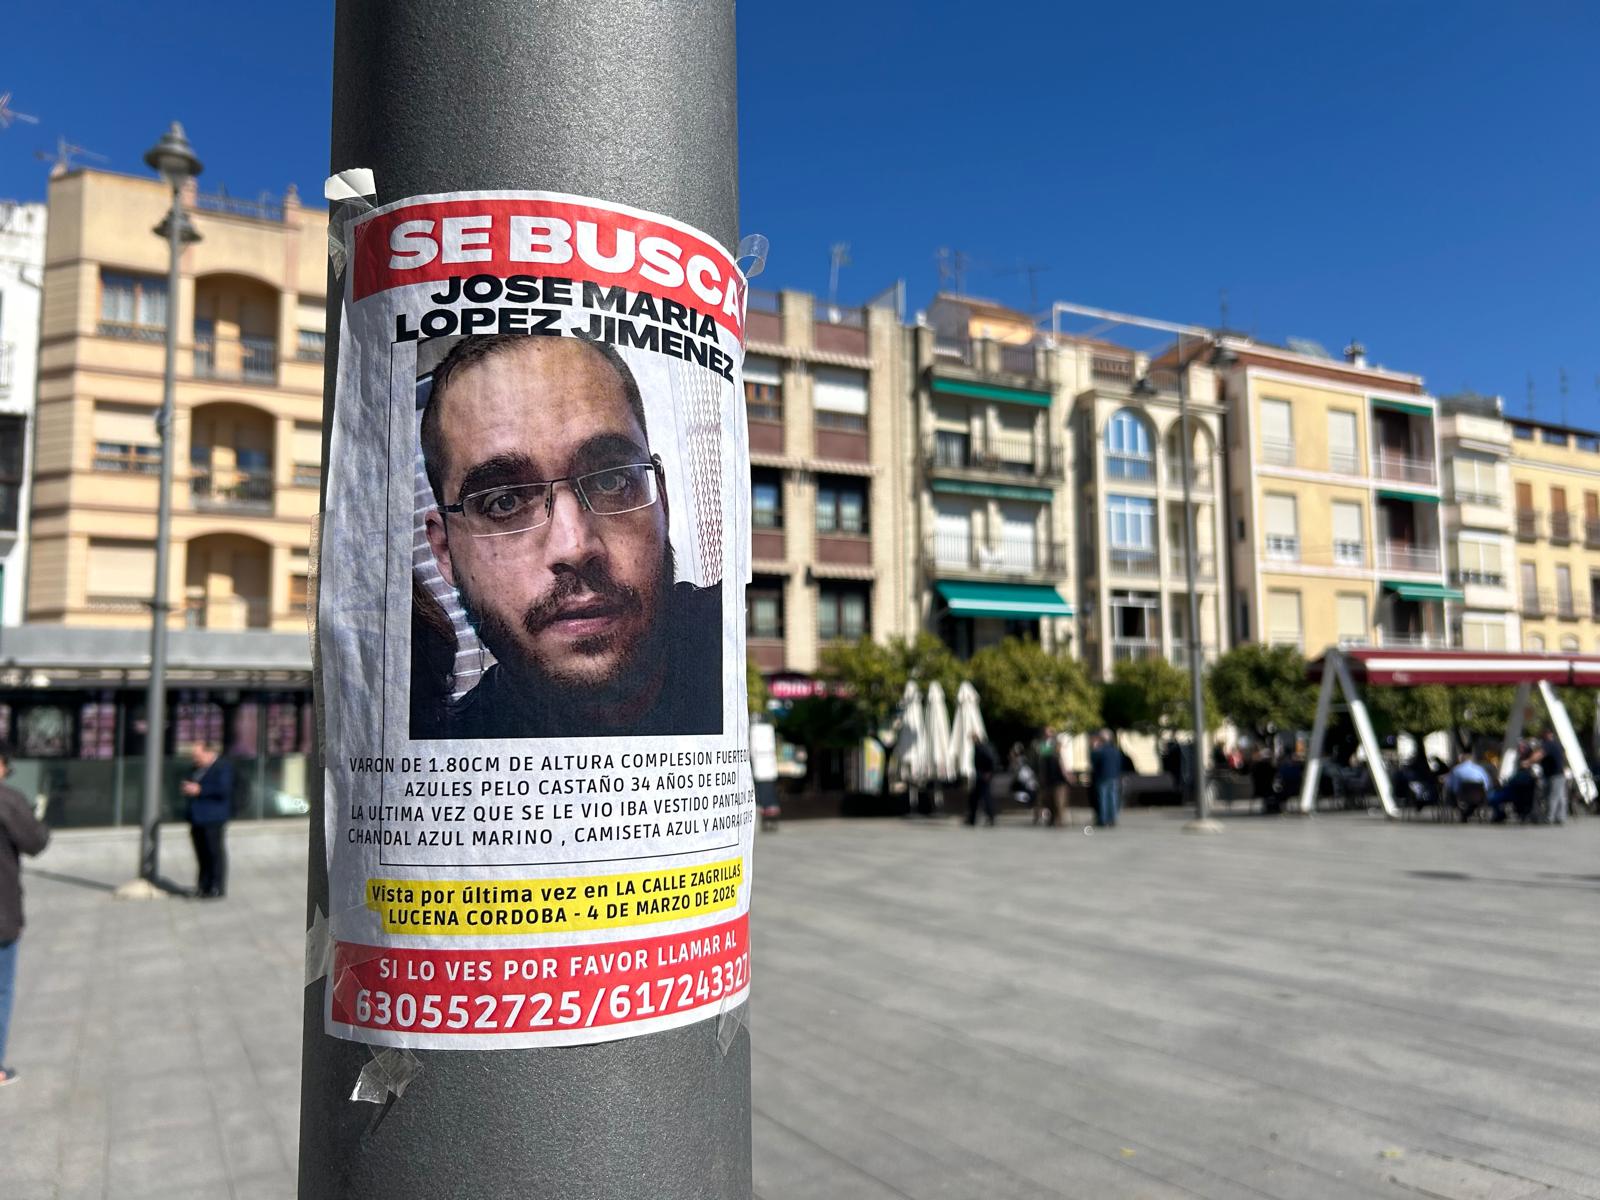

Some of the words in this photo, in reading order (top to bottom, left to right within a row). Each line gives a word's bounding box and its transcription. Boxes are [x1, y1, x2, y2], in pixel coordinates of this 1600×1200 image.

[388, 215, 493, 270] SE
[509, 215, 743, 329] BUSCA
[430, 273, 573, 306] JOSE
[582, 280, 720, 345] MARIA
[396, 307, 562, 342] LOPEZ
[570, 313, 734, 384] JIMENEZ
[349, 757, 394, 773] VARON
[401, 757, 422, 773] DE
[429, 756, 500, 773] 1.80CM
[509, 756, 533, 772] DE
[541, 754, 614, 771] ALTURA
[621, 751, 712, 769] COMPLESION
[405, 781, 472, 797] AZULES
[481, 780, 530, 797] PELO
[539, 775, 624, 795] CASTAÑO
[631, 777, 650, 792] 34
[656, 772, 694, 790] AÑOS
[698, 773, 712, 788] DE
[715, 771, 736, 786] EDAD
[351, 805, 363, 820] LA
[369, 805, 424, 822] ULTIMA
[431, 806, 465, 822] VEZ
[473, 805, 513, 822] QUE
[522, 804, 544, 820] SE
[553, 804, 573, 819] LE
[581, 802, 613, 818] VIO
[621, 800, 648, 816] IBA
[654, 796, 709, 814] VESTIDO
[348, 828, 411, 846] CHANDAL
[418, 831, 464, 846] AZUL
[472, 829, 553, 846] MARINO
[575, 823, 660, 843] CAMISETA
[666, 819, 699, 837] AZUL
[703, 818, 709, 832] Y
[372, 885, 414, 903] Vista
[421, 889, 455, 907] por
[462, 886, 532, 904] última
[541, 885, 576, 902] vez
[584, 884, 608, 899] en
[616, 880, 635, 896] LA
[642, 874, 686, 893] CALLE
[690, 863, 741, 887] ZAGRILLAS
[389, 908, 459, 926] LUCENA
[466, 908, 567, 925] CORDOBA
[587, 905, 598, 920] 4
[606, 902, 629, 919] DE
[636, 895, 690, 916] MARZO
[695, 890, 709, 907] DE
[712, 884, 736, 903] 2026
[379, 958, 398, 979] SI
[408, 960, 435, 981] LO
[445, 960, 492, 981] VES
[504, 958, 558, 981] POR
[570, 949, 648, 977] FAVOR
[657, 934, 720, 966] LLAMAR
[724, 929, 737, 950] AL
[356, 952, 748, 1027] 630552725/617243327
